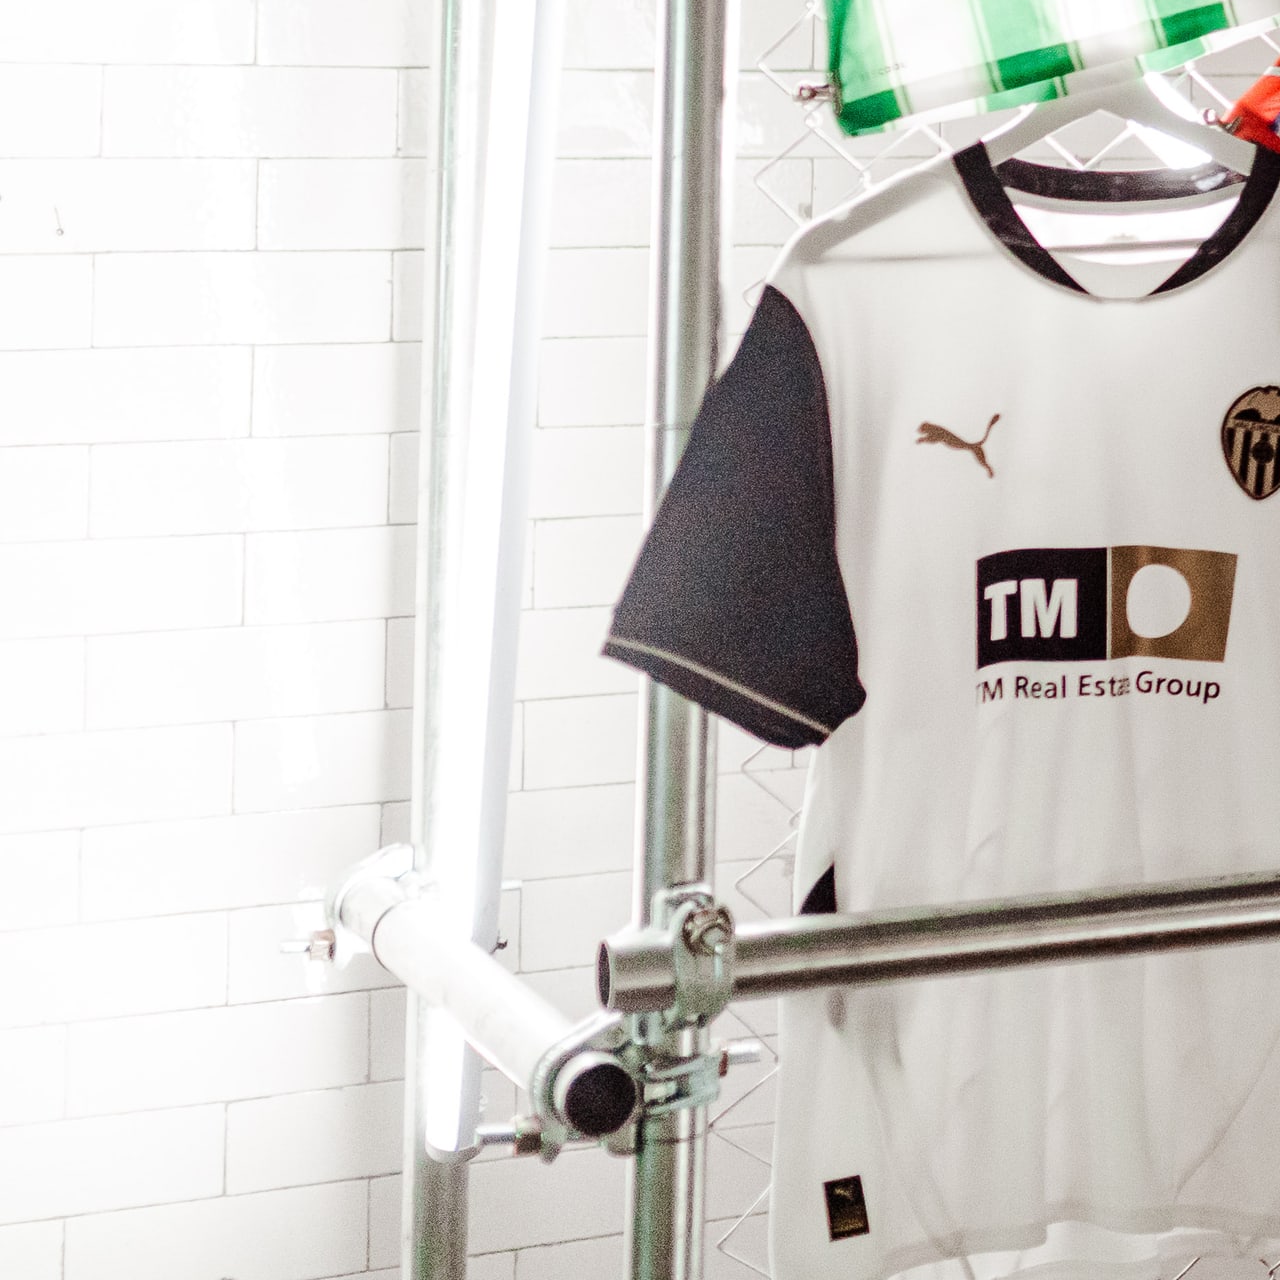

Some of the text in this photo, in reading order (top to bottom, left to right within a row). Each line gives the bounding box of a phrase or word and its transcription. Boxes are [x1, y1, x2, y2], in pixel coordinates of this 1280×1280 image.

[983, 577, 1078, 642] TM
[1014, 675, 1067, 699] Real
[1135, 670, 1221, 705] Group
